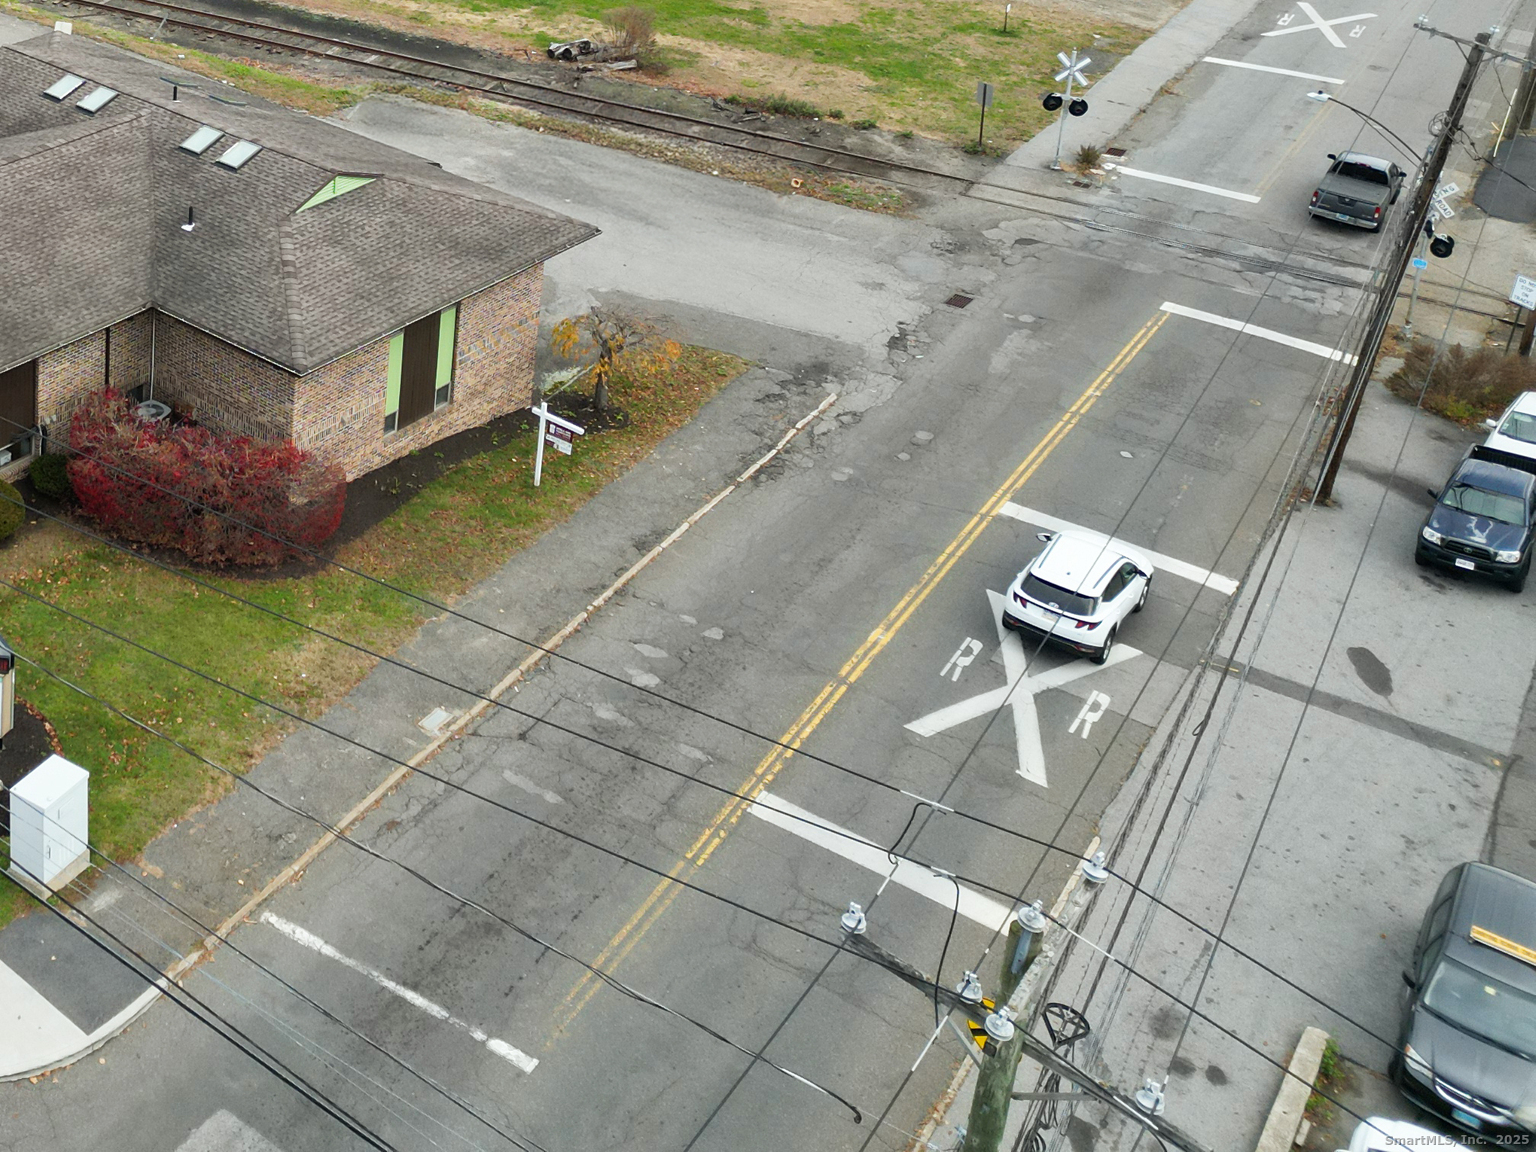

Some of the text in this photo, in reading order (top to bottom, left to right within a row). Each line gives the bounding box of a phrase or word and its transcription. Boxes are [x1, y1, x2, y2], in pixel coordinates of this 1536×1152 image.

[1349, 24, 1367, 38] R
[1520, 285, 1534, 293] STOP
[1514, 294, 1534, 307] TRACKS
[939, 636, 984, 682] R
[1067, 690, 1112, 739] R
